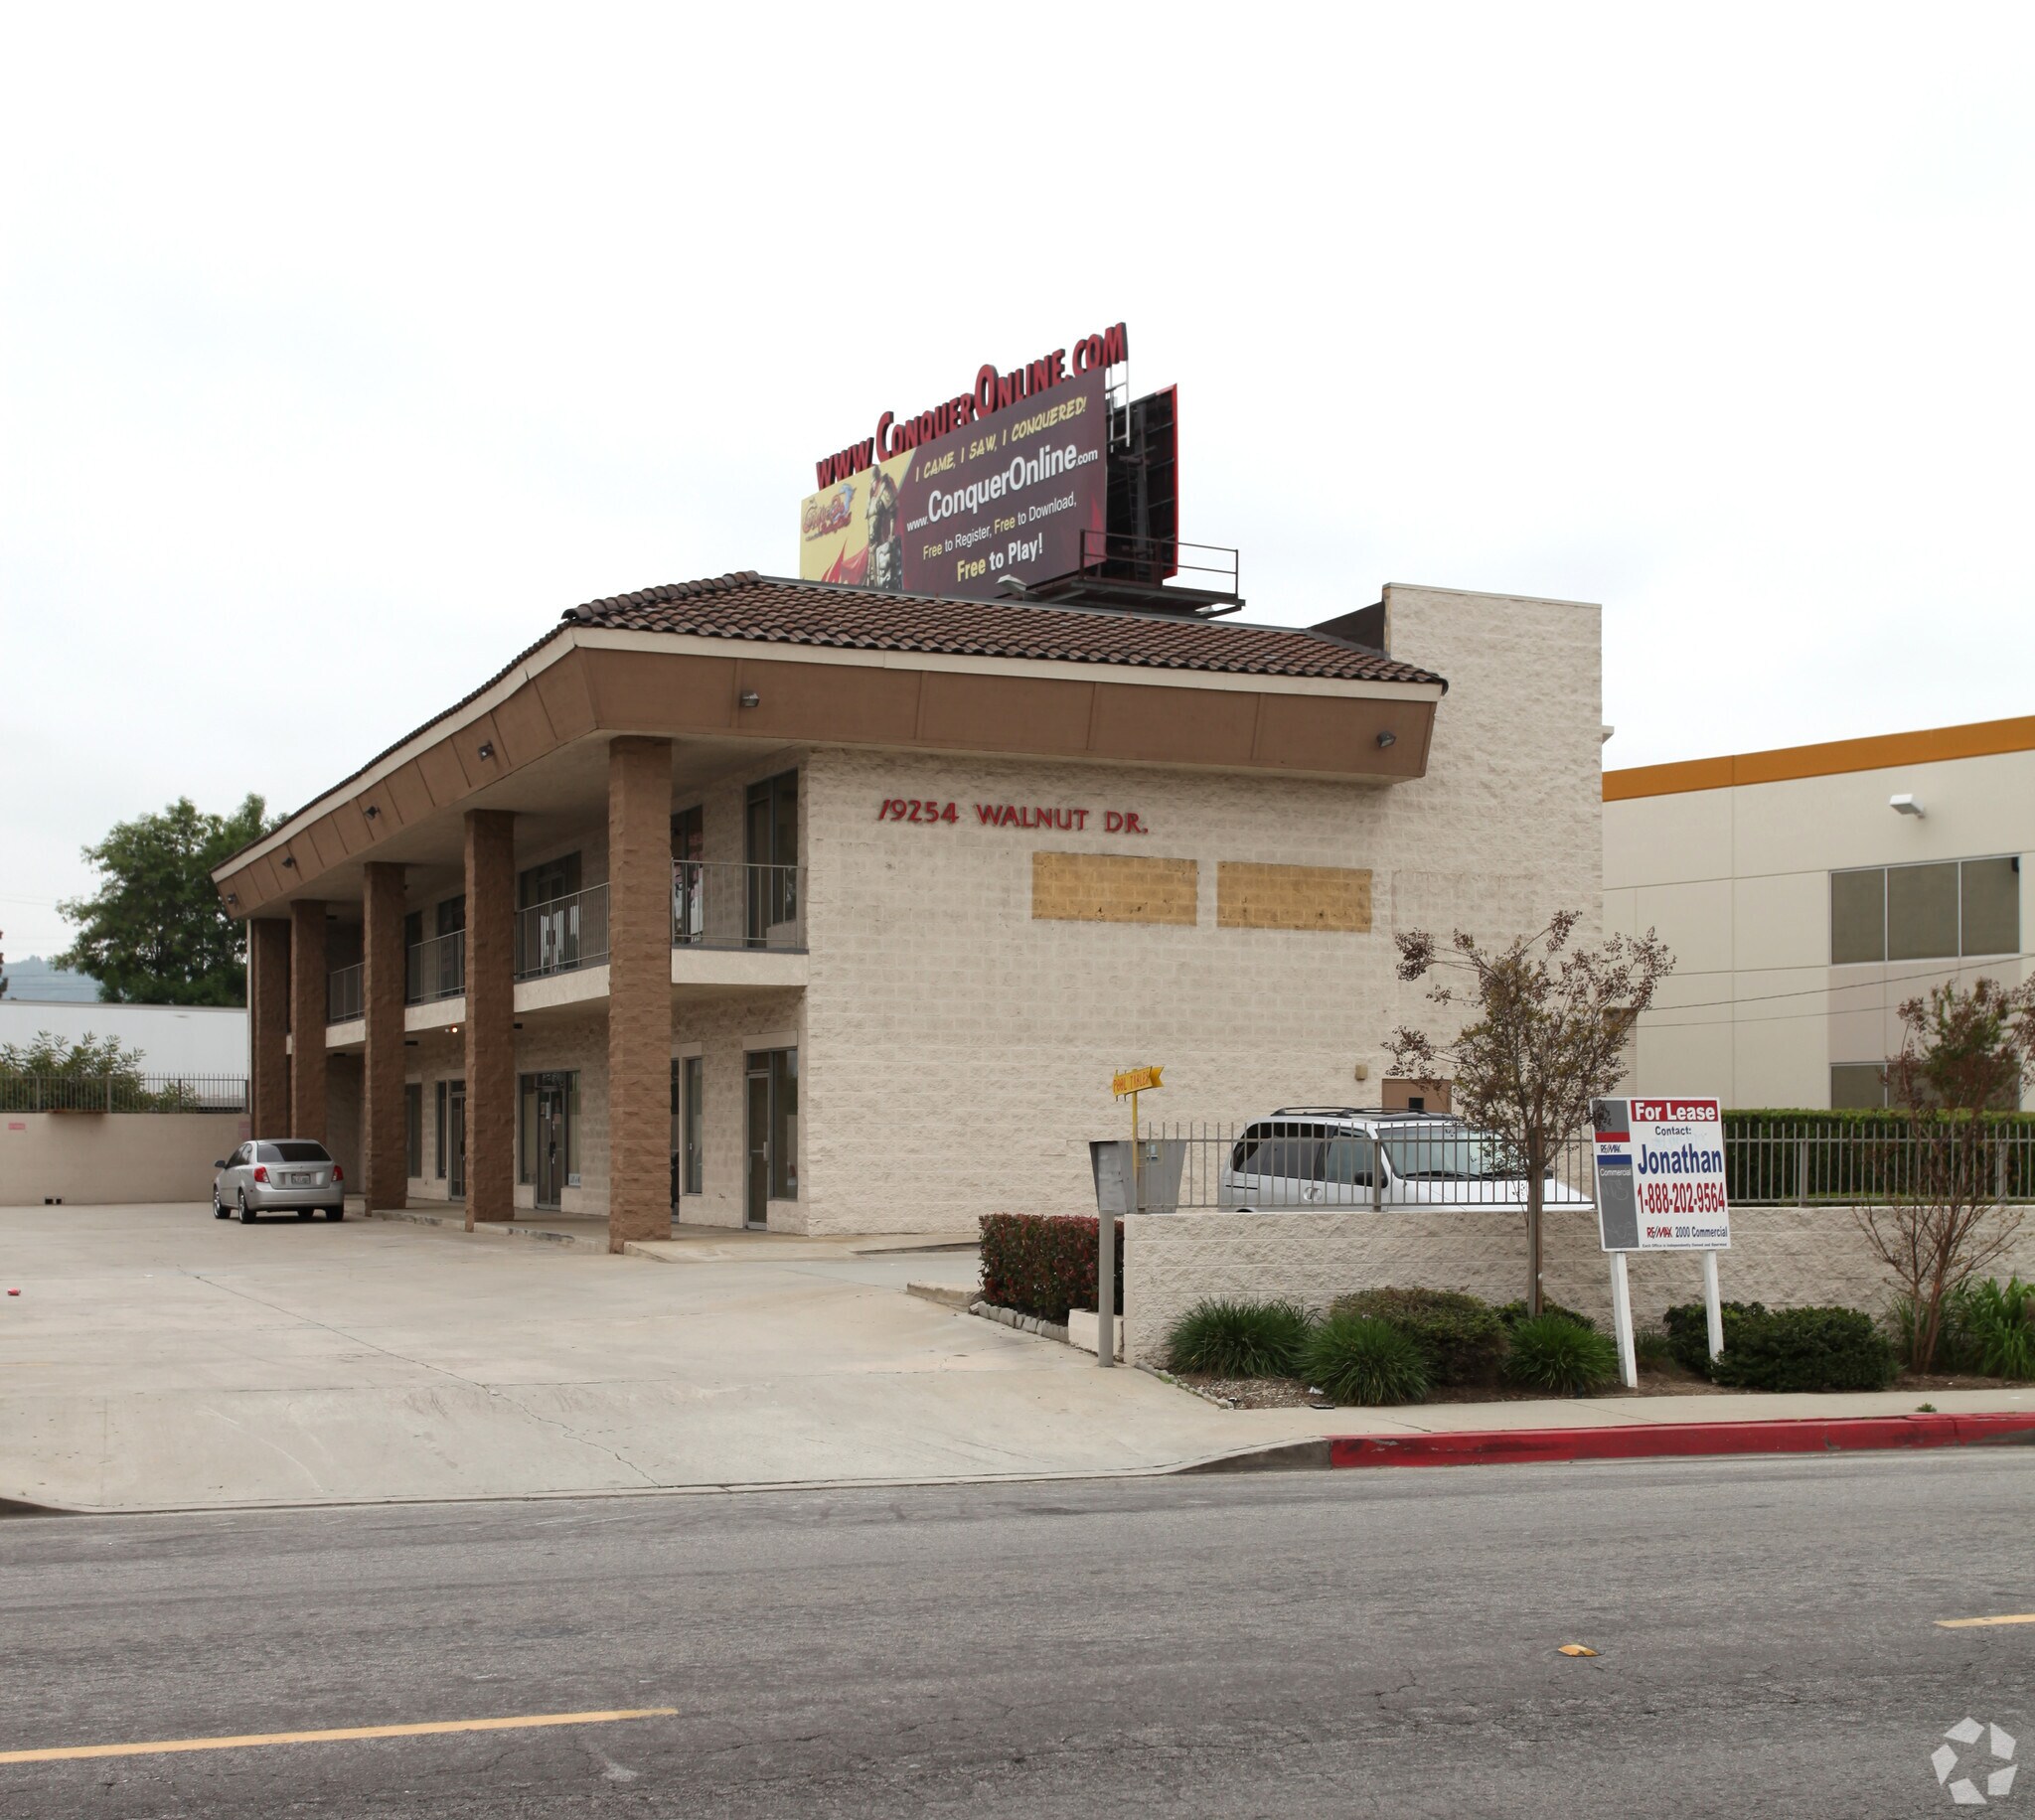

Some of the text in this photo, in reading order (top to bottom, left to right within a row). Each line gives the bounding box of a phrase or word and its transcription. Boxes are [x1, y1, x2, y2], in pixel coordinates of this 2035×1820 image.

[915, 396, 1087, 483] I CAME, I SAW, I CONQUERED!
[923, 491, 1077, 560] Free to Register, Free to Download,
[957, 532, 1043, 582] Free to Play!
[878, 799, 1149, 834] 19254 WALNUT DR.
[1635, 1102, 1716, 1121] For Lease
[1654, 1126, 1692, 1136] Contact:
[1600, 1167, 1632, 1176] Commercial
[1638, 1143, 1723, 1174] Jonathan
[1638, 1182, 1725, 1214] 1-888-202-9564
[1646, 1226, 1728, 1239] RE/MAX 2000 Commercial
